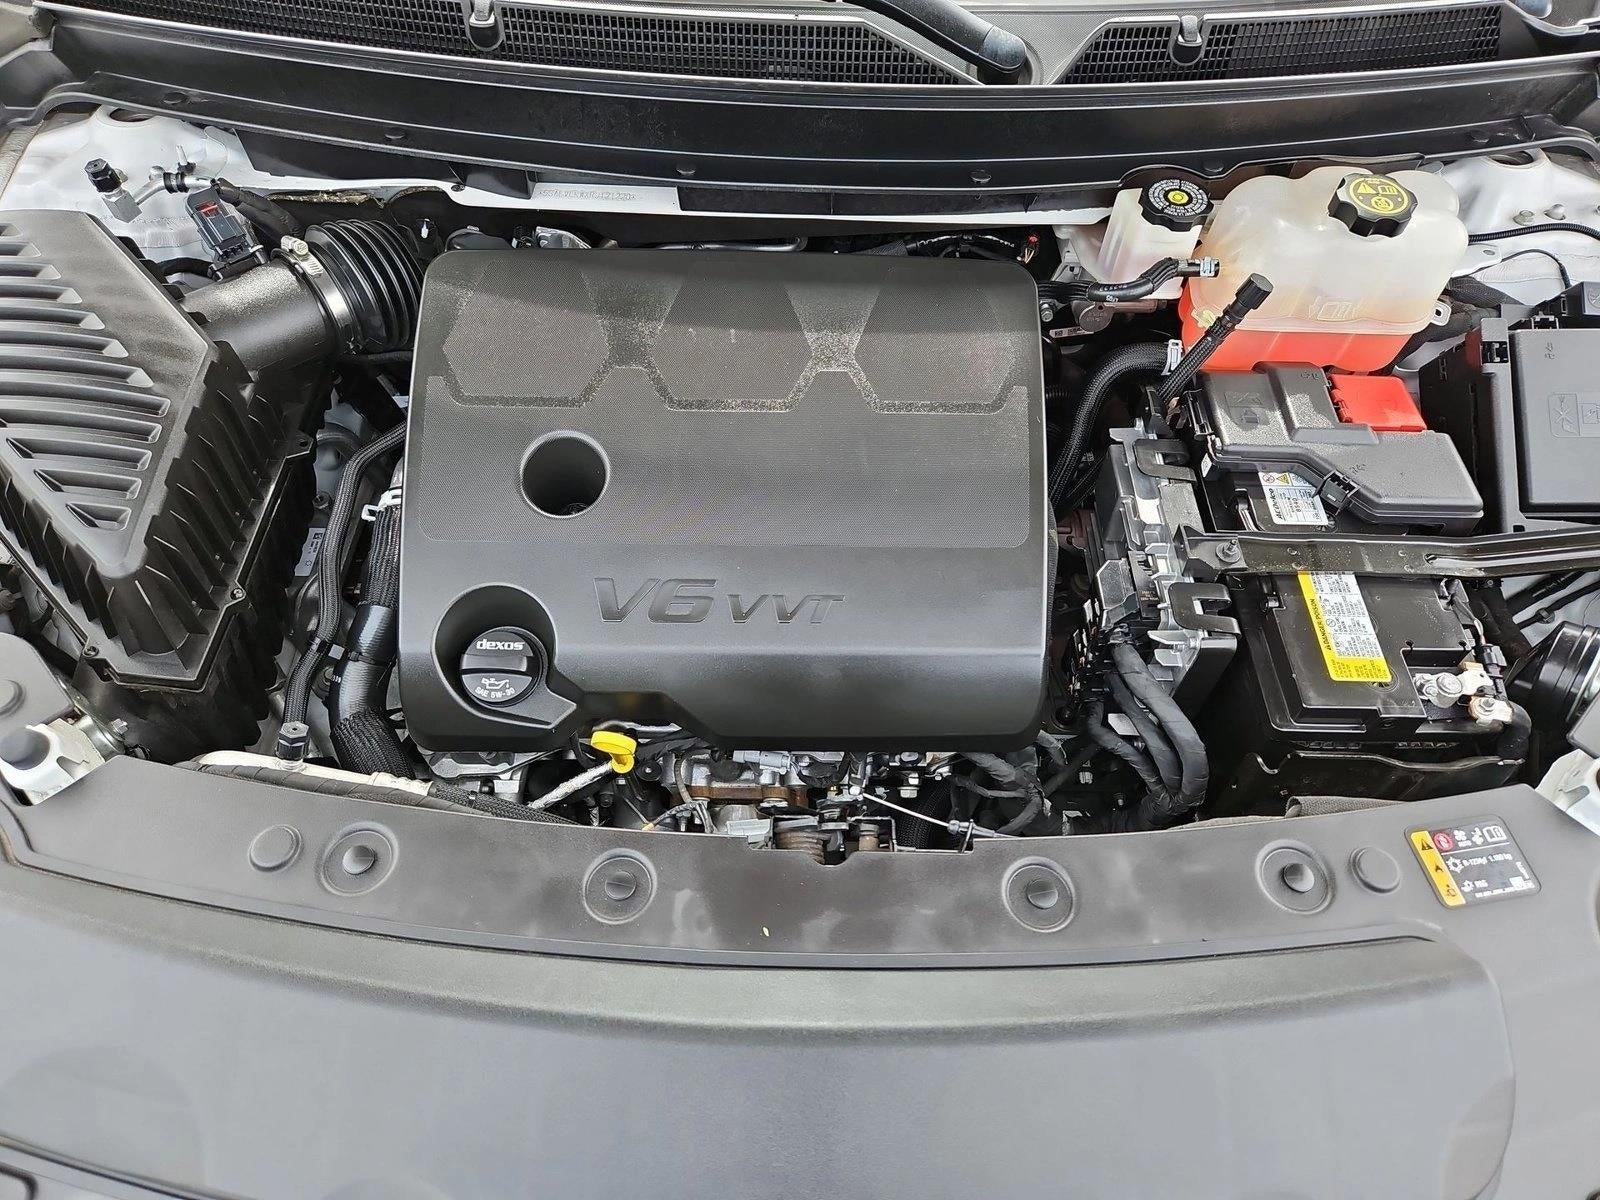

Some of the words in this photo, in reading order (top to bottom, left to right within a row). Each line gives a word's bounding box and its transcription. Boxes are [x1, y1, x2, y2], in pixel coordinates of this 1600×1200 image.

[593, 577, 718, 624] V6
[726, 594, 846, 625] VVT
[1309, 598, 1322, 620] POISON
[475, 638, 527, 651] dexos
[1318, 621, 1330, 646] DANGER
[474, 686, 490, 698] SAE
[490, 687, 516, 699] 5W-30
